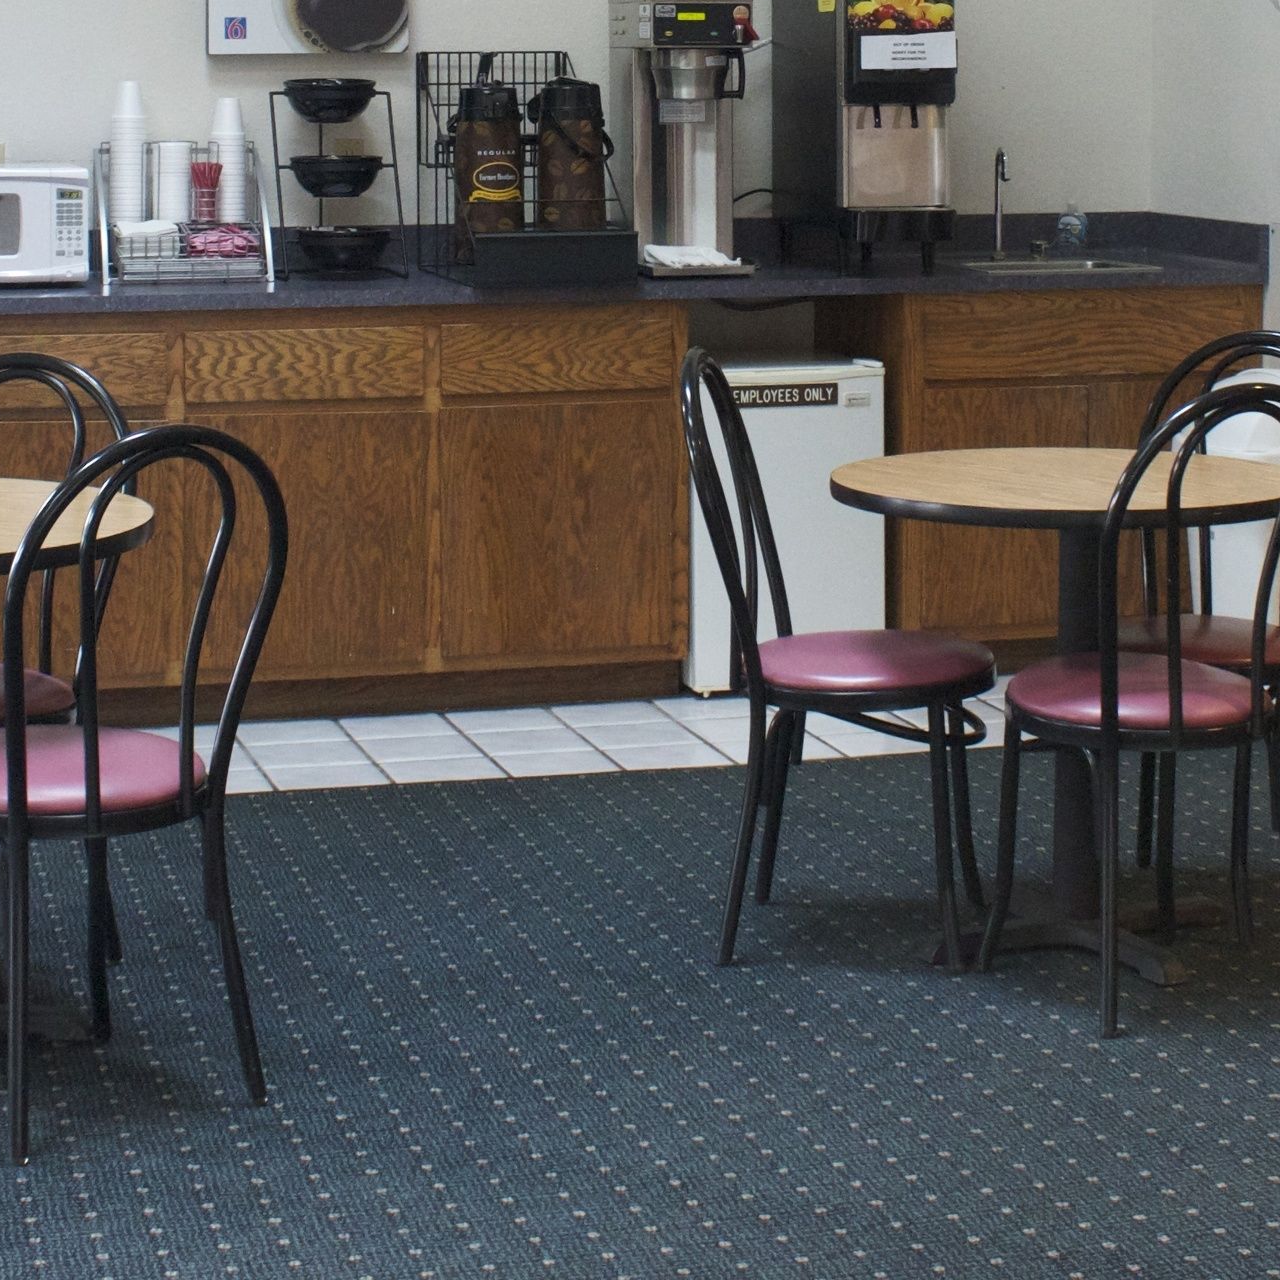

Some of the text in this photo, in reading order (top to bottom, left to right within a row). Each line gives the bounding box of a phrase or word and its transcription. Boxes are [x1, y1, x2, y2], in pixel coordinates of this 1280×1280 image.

[228, 17, 246, 39] 6
[733, 387, 834, 404] EMPLOYEES ONLY
